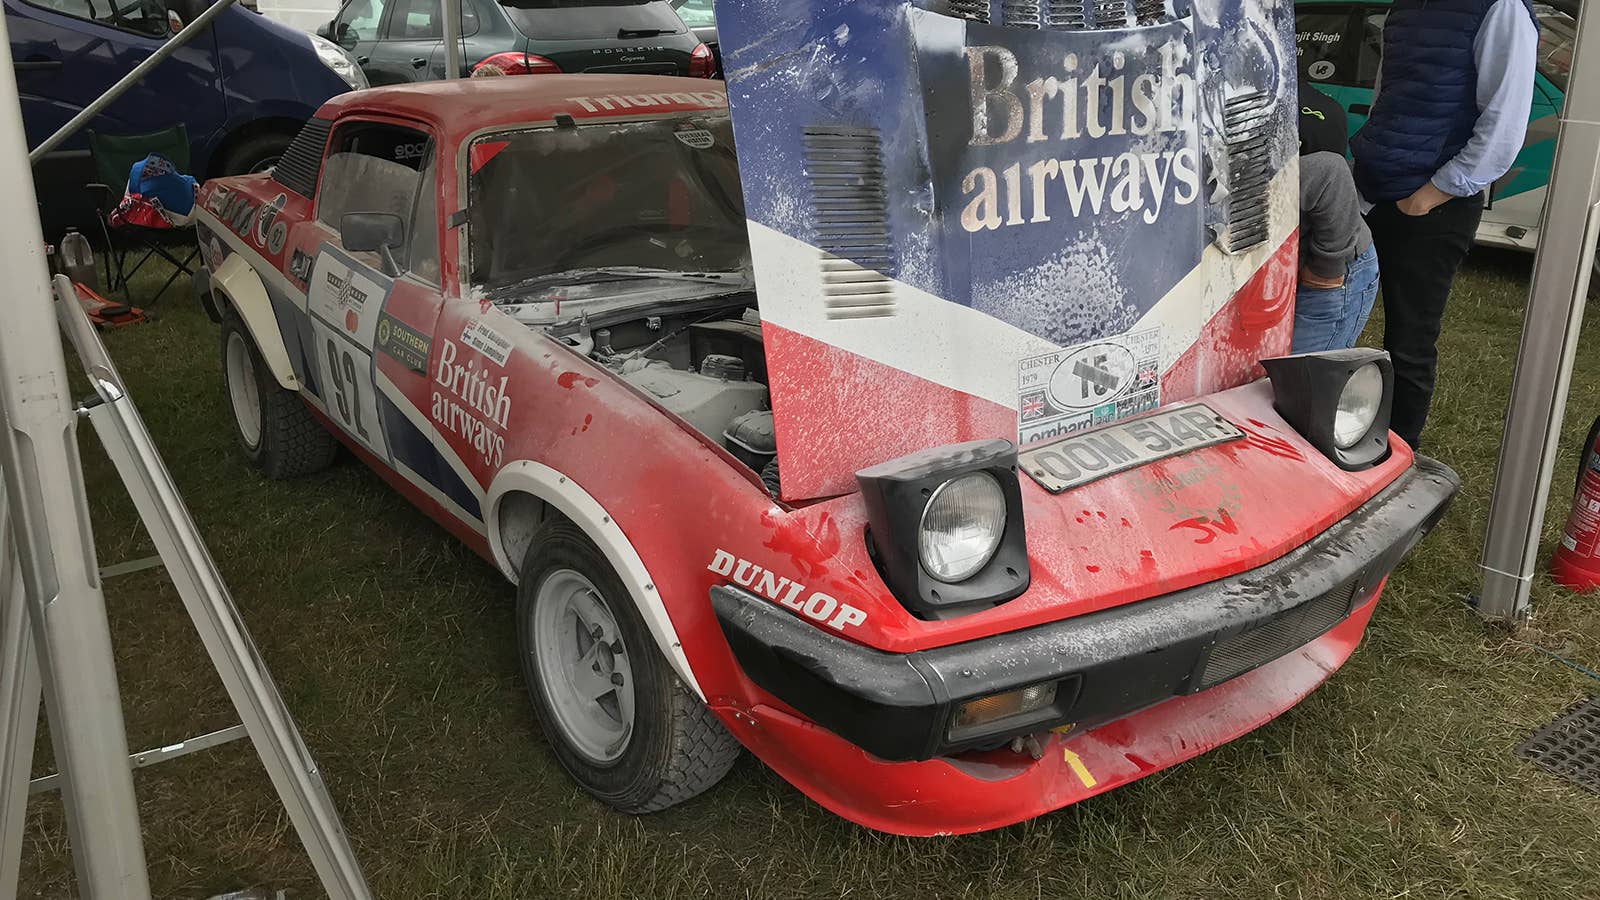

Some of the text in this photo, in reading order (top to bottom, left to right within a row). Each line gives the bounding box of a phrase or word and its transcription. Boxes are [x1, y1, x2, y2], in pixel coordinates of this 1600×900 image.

[592, 46, 665, 55] PORSCHE
[1296, 32, 1340, 43] njit Singh
[566, 91, 727, 112] Triump
[966, 39, 1197, 146] British
[961, 148, 1200, 233] airways
[393, 325, 429, 353] SOUTHERN
[1125, 330, 1159, 346] CHESTER
[392, 345, 423, 369] CAR CLUB
[1020, 354, 1061, 371] CHESTER
[326, 338, 372, 445] 92
[435, 338, 513, 431] British
[1022, 373, 1038, 386] 1979
[431, 391, 505, 469] airways
[1034, 432, 1139, 481] OOM
[706, 548, 868, 631] DUNLOP
